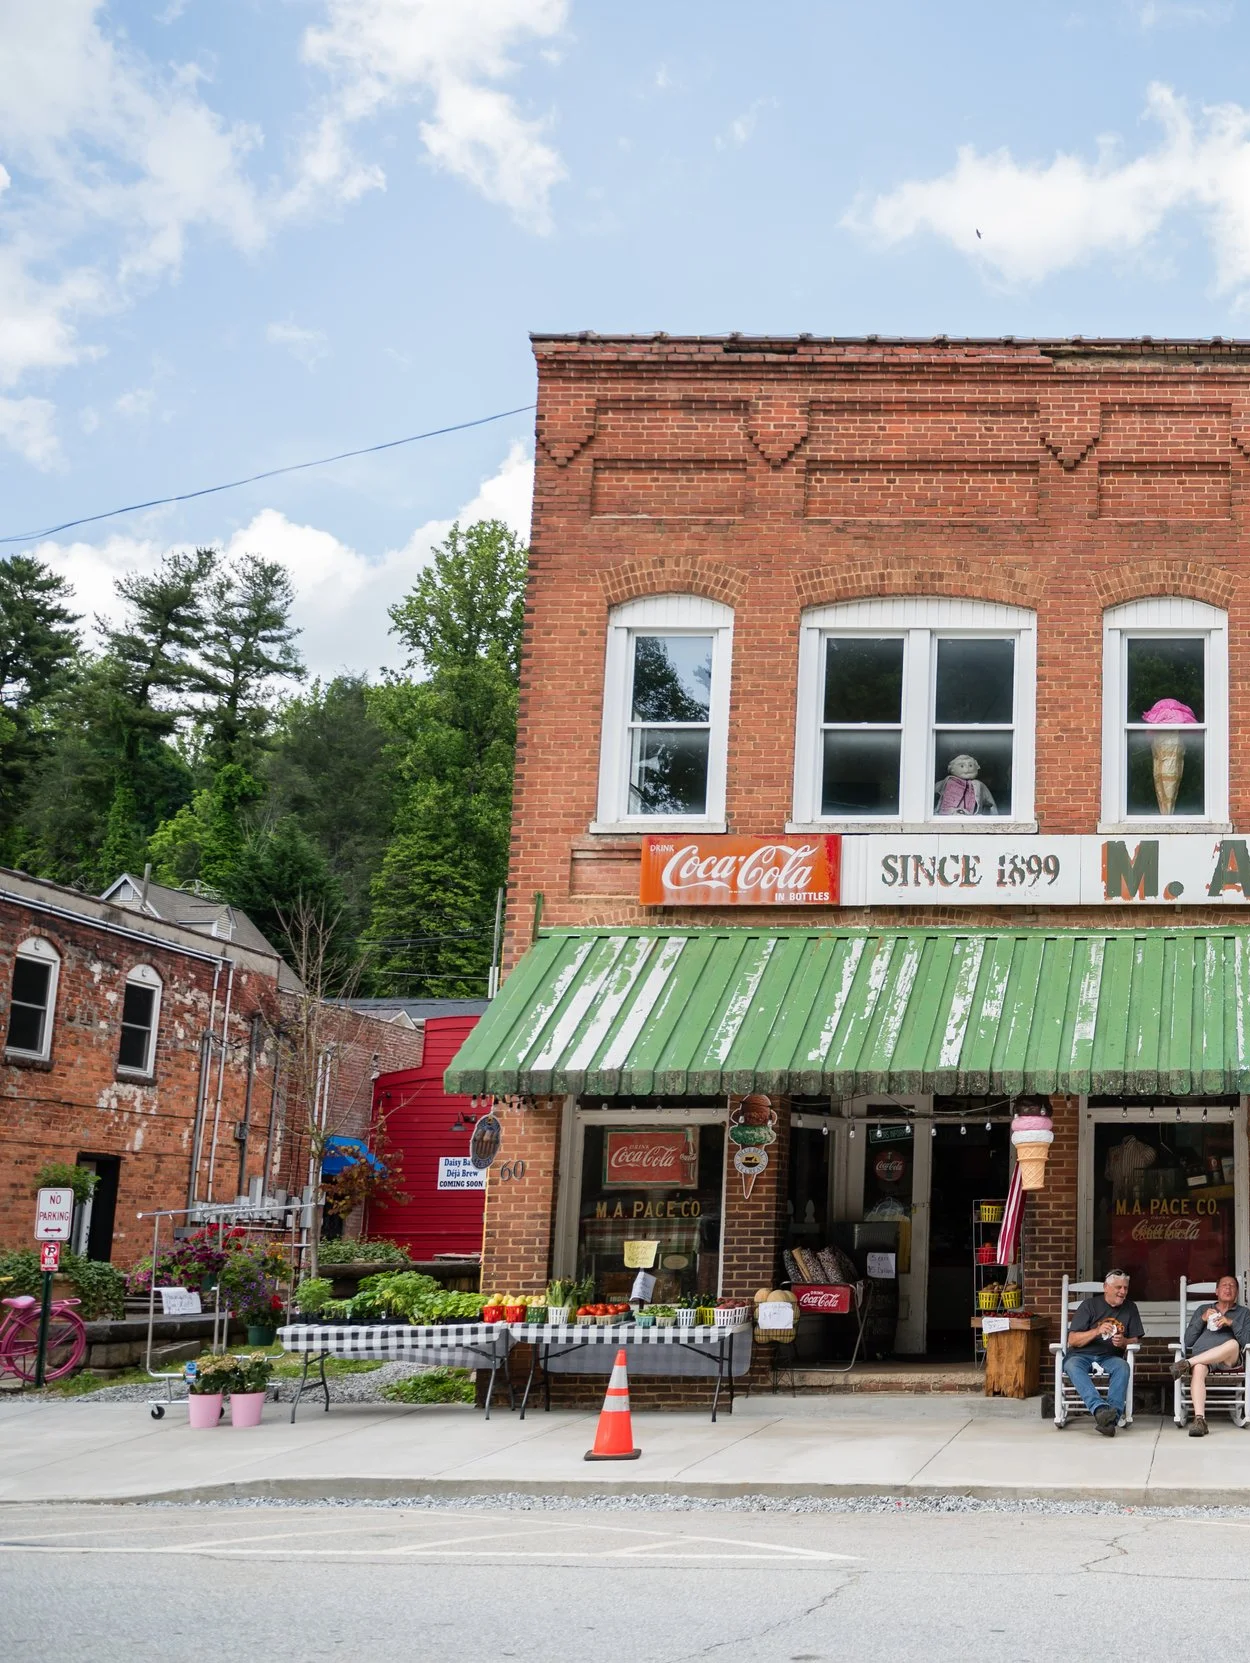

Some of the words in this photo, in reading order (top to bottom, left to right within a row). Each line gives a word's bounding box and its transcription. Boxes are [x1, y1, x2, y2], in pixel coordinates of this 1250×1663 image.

[650, 844, 675, 852] DRINK
[662, 844, 819, 890] Coca-Cola
[881, 854, 983, 887] SINCE
[996, 854, 1060, 887] 1899
[775, 892, 785, 901] IN
[789, 891, 830, 901] BOTTLES
[444, 1158, 461, 1167] Daisy
[610, 1145, 679, 1168] Coca-Cola
[461, 1169, 479, 1177] Brew
[500, 1160, 525, 1182] 60
[439, 1180, 465, 1188] COMING
[466, 1180, 483, 1188] SOON
[49, 1194, 62, 1205] NO
[633, 1200, 676, 1218] PACE
[1150, 1199, 1190, 1215] PACE
[1196, 1199, 1220, 1215] CO.
[40, 1211, 70, 1222] PARKING
[800, 1292, 840, 1308] Coca-Cola
